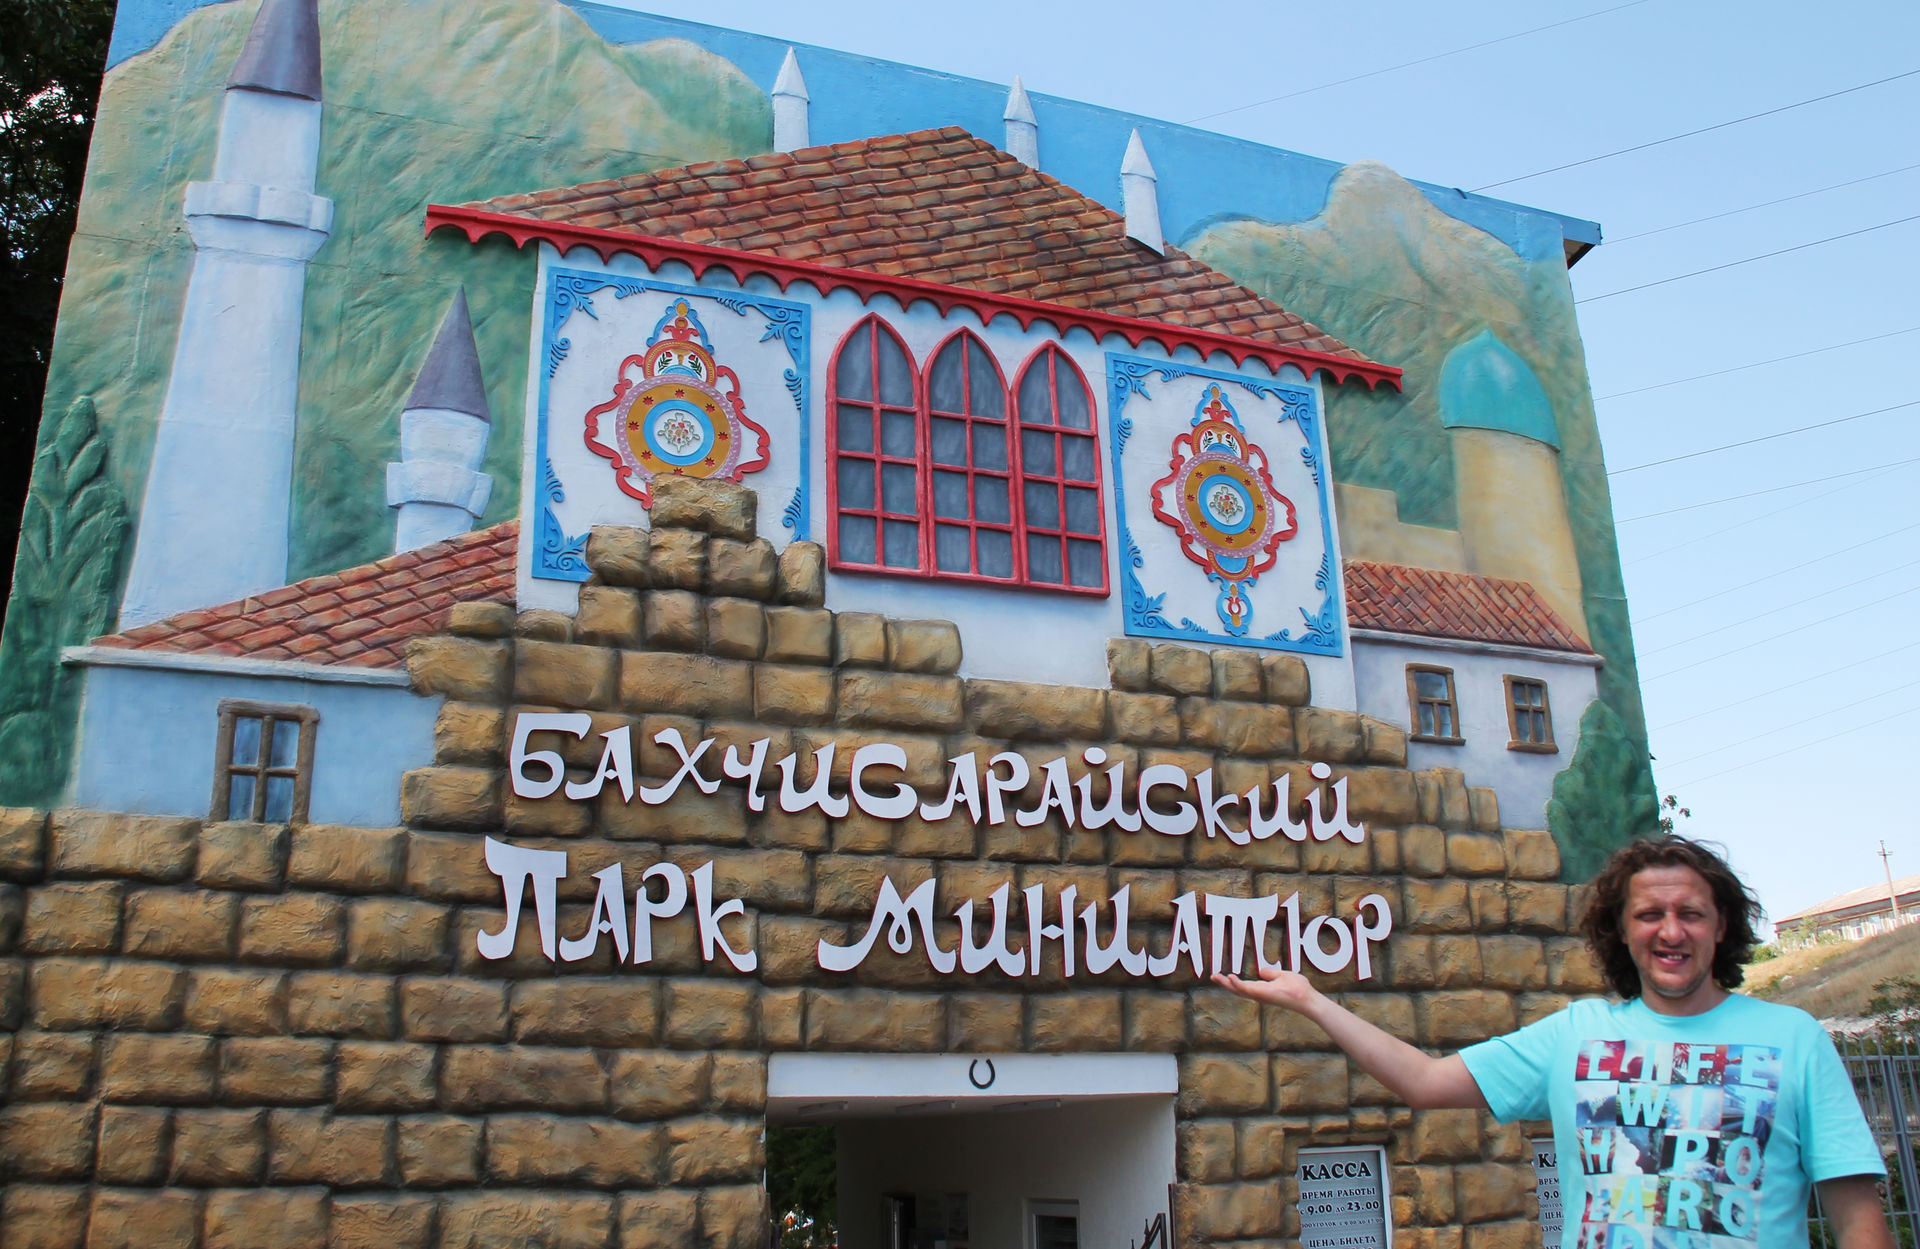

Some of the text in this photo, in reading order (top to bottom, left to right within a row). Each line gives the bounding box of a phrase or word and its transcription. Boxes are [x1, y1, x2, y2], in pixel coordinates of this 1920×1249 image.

[1587, 1042, 1770, 1088] LIFE
[1617, 1083, 1767, 1134] WIT
[1301, 1161, 1372, 1181] КАССА
[1302, 1187, 1376, 1200] ВРЕМЯ РАБОТЫ
[1307, 1204, 1333, 1216] 9.00
[1347, 1201, 1379, 1212] 23.00
[1545, 1211, 1564, 1220] ЦЕН
[1309, 1235, 1377, 1249] ЦЕНА БИЛЕТА
